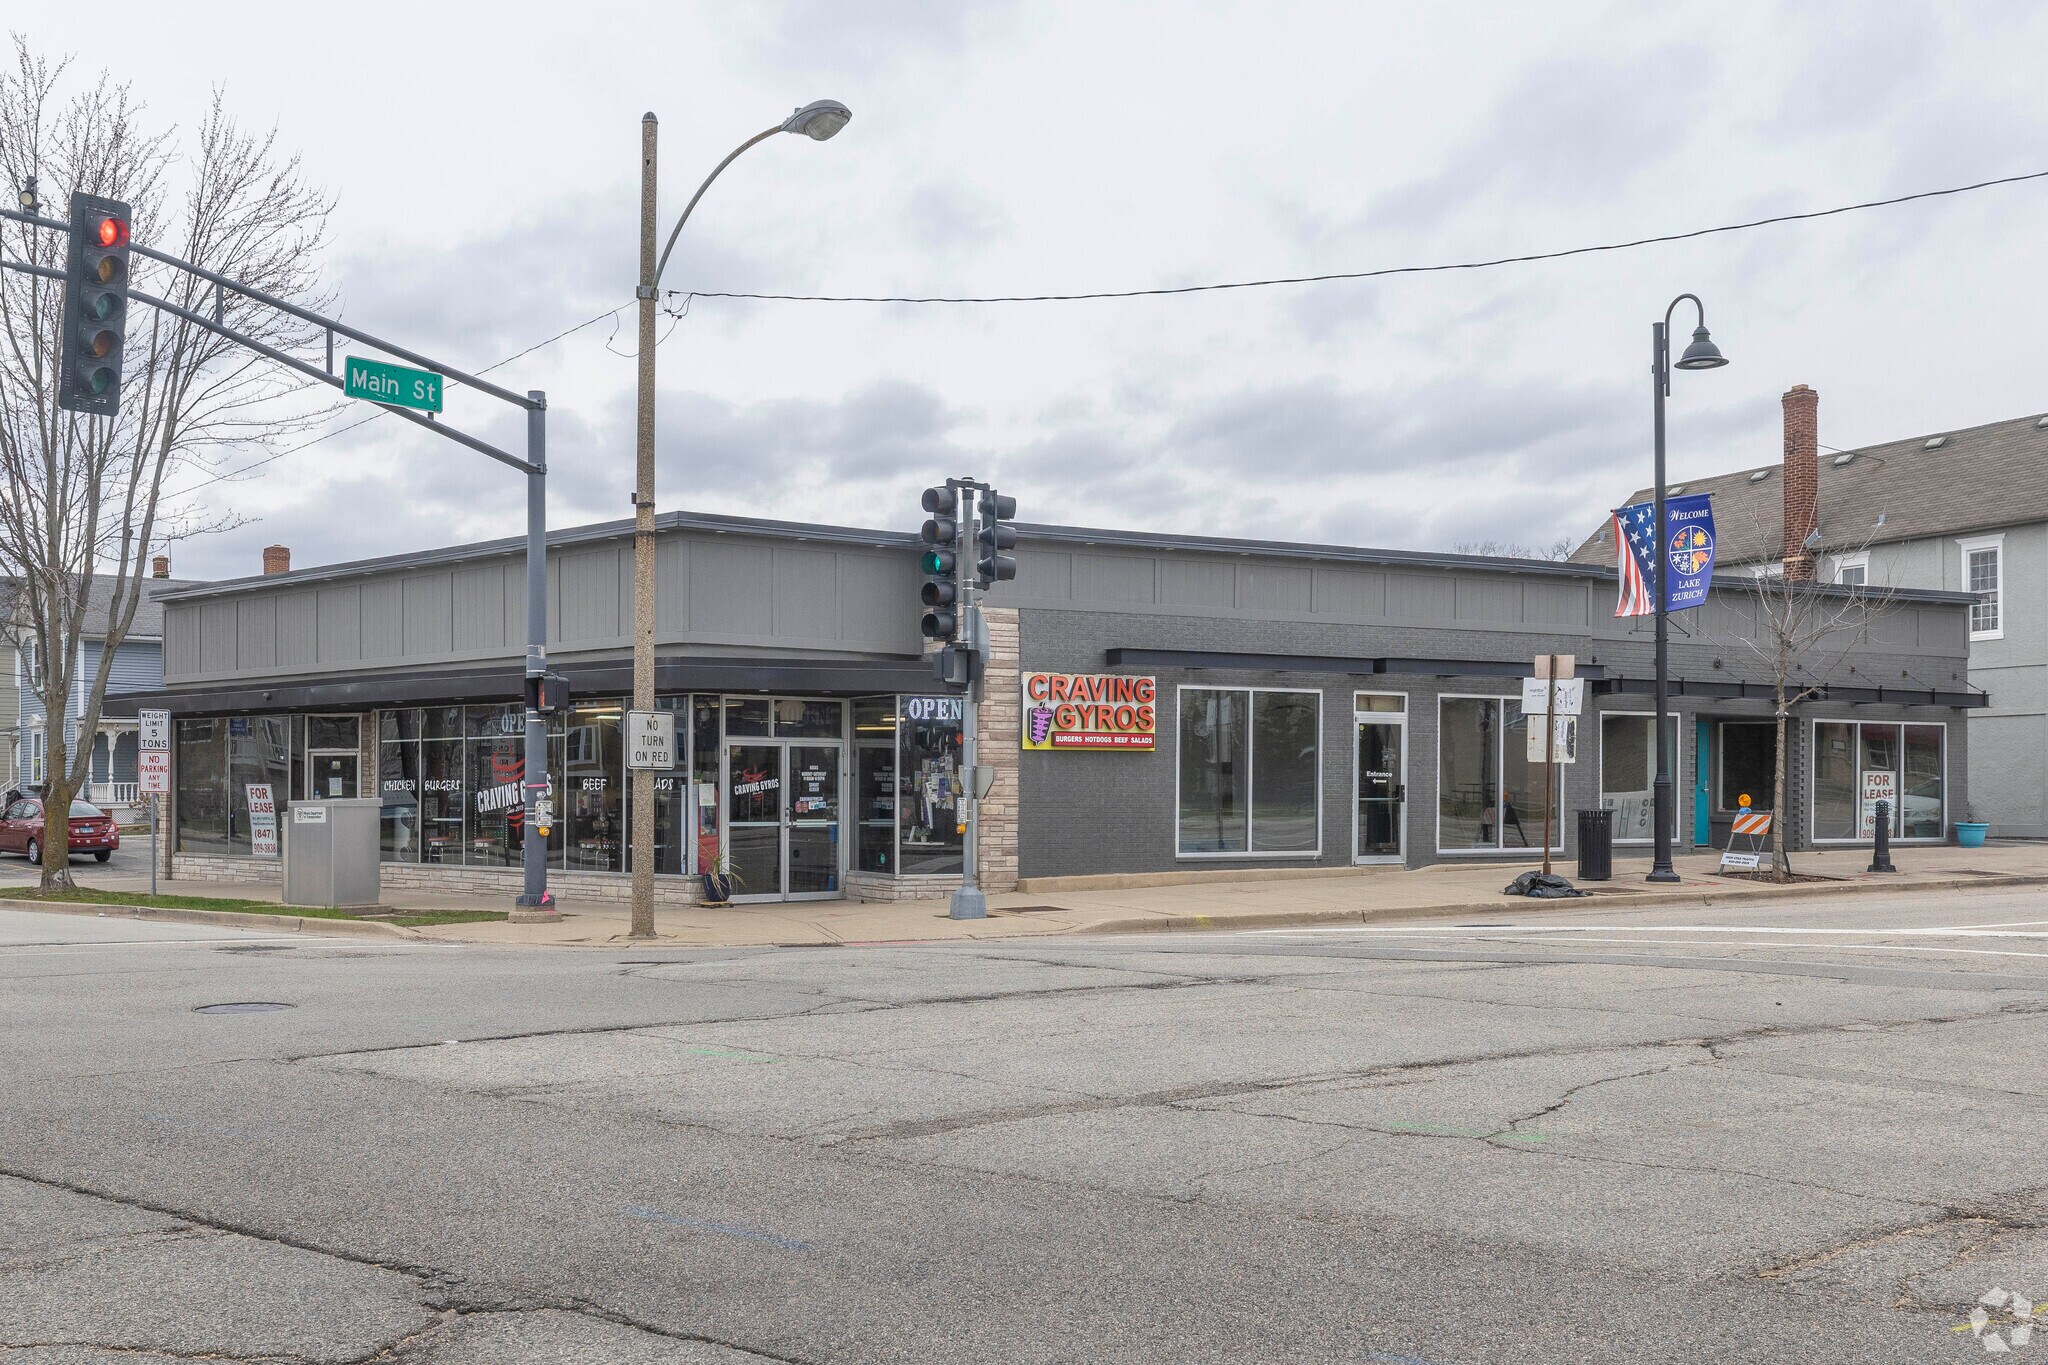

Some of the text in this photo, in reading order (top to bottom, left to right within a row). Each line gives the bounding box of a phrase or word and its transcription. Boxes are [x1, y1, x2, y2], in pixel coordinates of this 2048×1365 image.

[352, 367, 436, 402] Main St
[1678, 578, 1701, 589] LAKE
[1672, 589, 1704, 602] ZURICH
[1028, 674, 1155, 703] CRAVING
[908, 698, 962, 720] OPEN
[501, 712, 526, 732] OPE
[1054, 703, 1155, 731] GYROS
[647, 720, 658, 731] NO
[152, 729, 158, 737] 5
[142, 740, 167, 748] TONS
[642, 735, 664, 746] TURN
[636, 751, 668, 762] ON RED
[141, 765, 168, 773] PARKING
[384, 779, 416, 791] CHICKEN
[424, 780, 460, 792] BURGERS
[582, 778, 607, 791] BEEF
[654, 778, 674, 790] ADS
[1867, 774, 1890, 786] FOR
[734, 778, 779, 795] CRAVING GYROS
[250, 788, 268, 799] FOR
[477, 782, 518, 813] CRAVING
[1864, 789, 1894, 800] LEASE
[250, 802, 273, 813] LEASE
[1865, 816, 1891, 826] (8)
[255, 829, 274, 840] (847)
